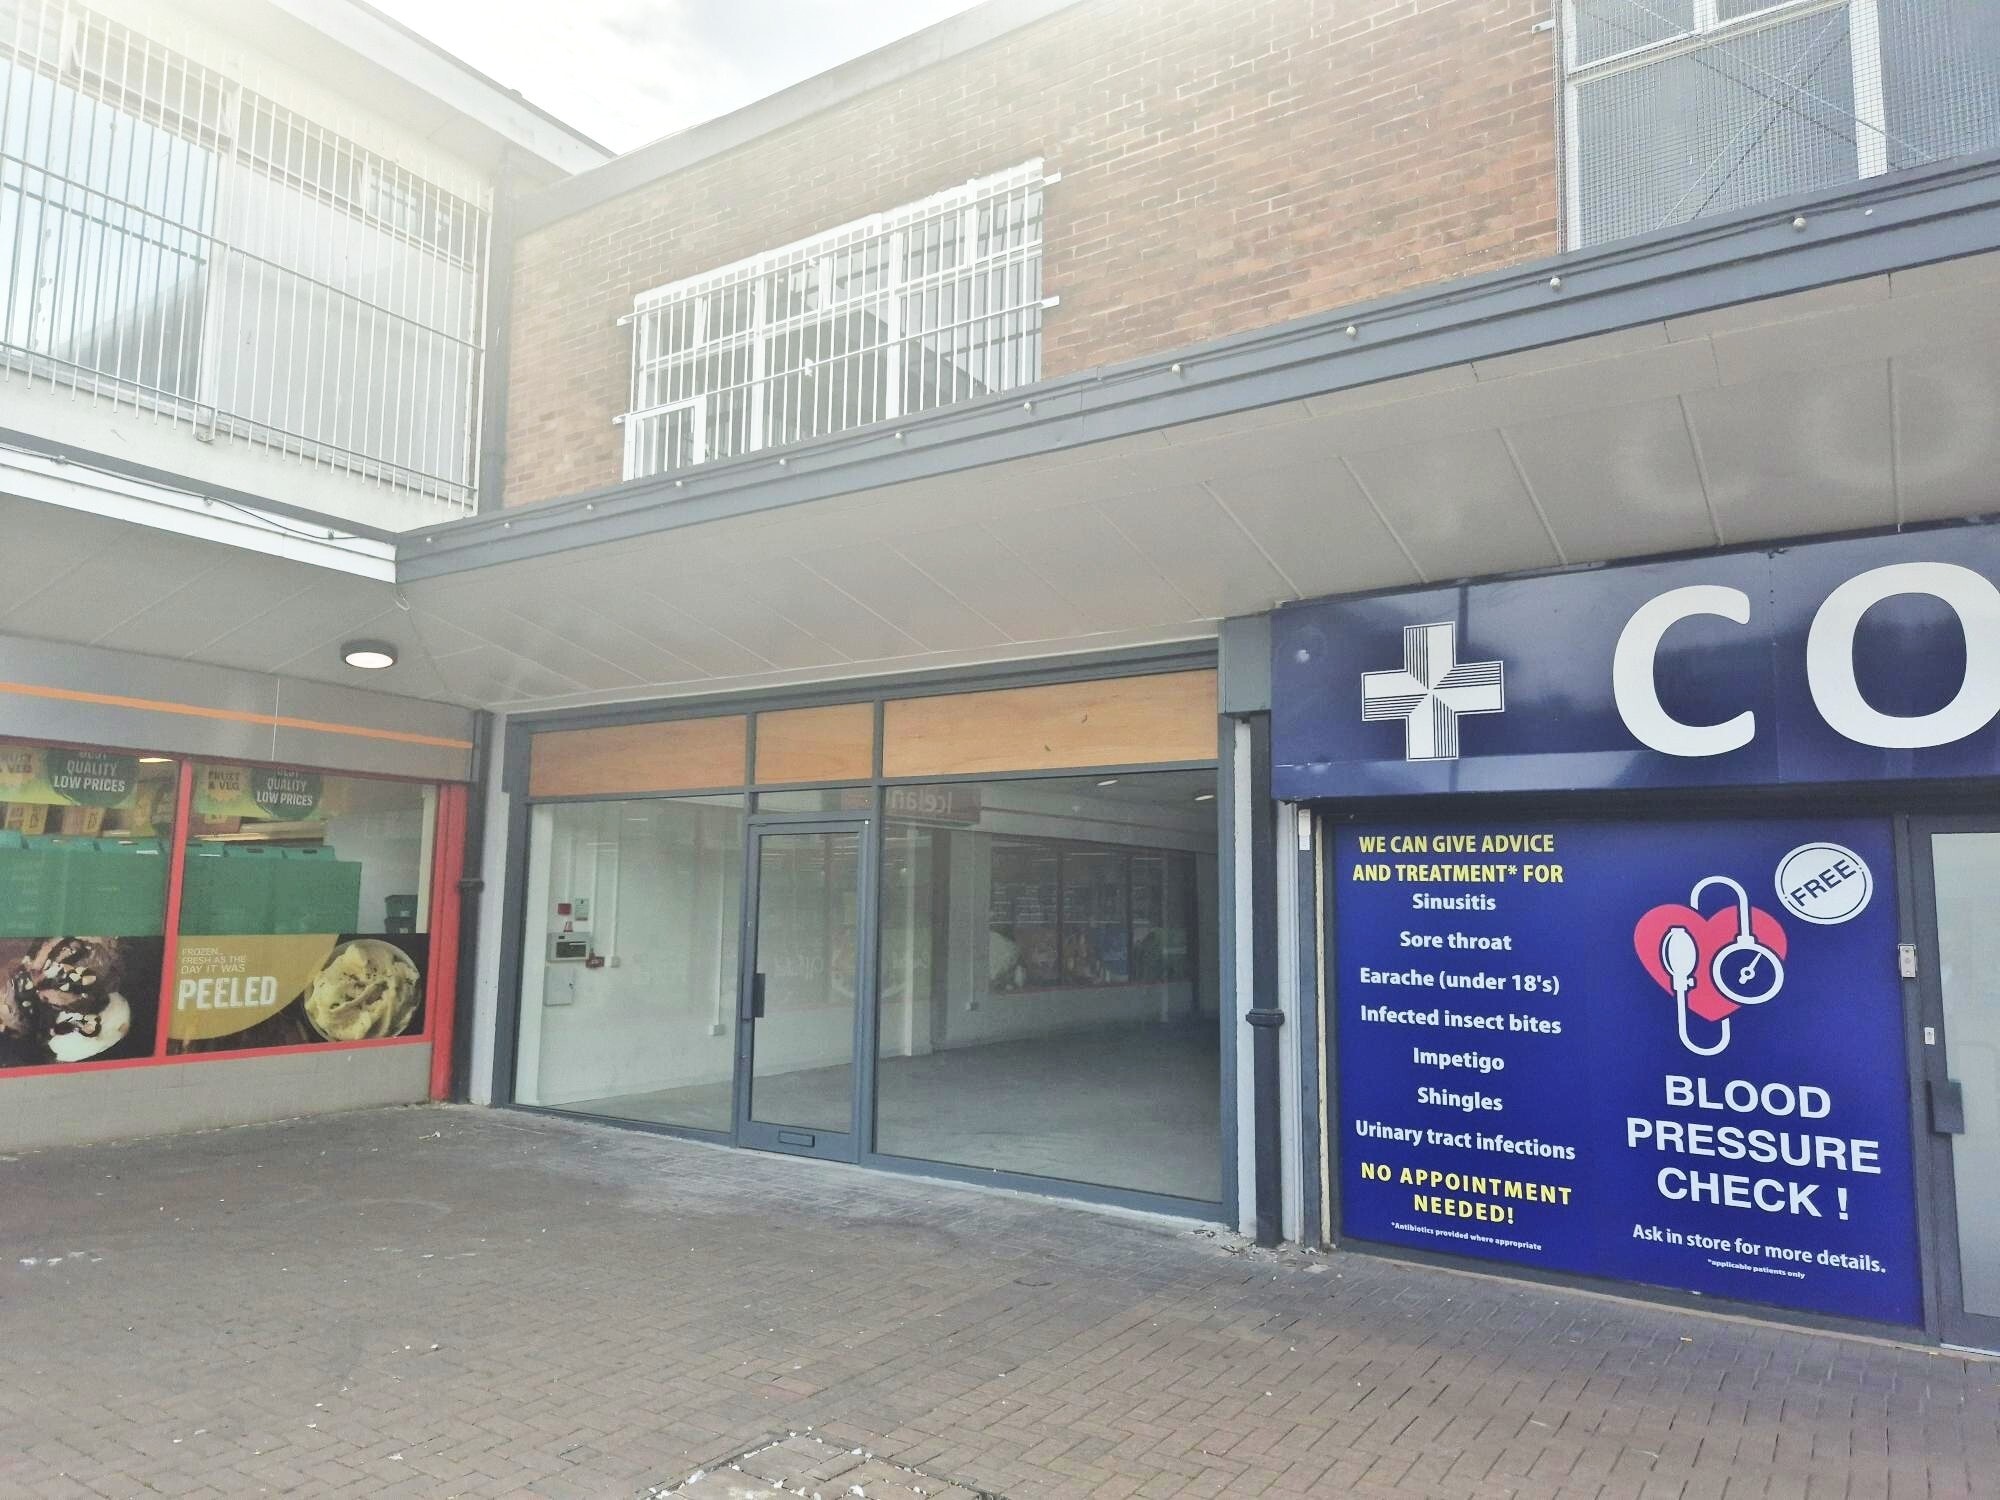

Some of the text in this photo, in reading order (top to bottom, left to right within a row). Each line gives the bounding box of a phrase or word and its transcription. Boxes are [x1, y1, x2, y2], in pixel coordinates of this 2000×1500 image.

[1612, 561, 2000, 758] CO
[66, 760, 118, 776] QUALITY
[54, 775, 125, 792] LOW PRICES
[267, 778, 306, 792] QUALITY
[256, 791, 313, 807] LOW PRICES
[1359, 834, 1555, 853] WE CAN GIVE ADVICE
[1353, 864, 1391, 882] AND
[1523, 865, 1564, 883] FOR
[1789, 858, 1857, 907] FREE
[1412, 893, 1497, 911] Sinusitis
[1400, 931, 1512, 950] Sore throat
[181, 963, 246, 975] DAY IT WAS
[182, 954, 246, 966] FRESH AS THE
[178, 976, 278, 1010] PEELED
[1360, 967, 1560, 995] Earache (under 18's)
[1360, 1005, 1562, 1034] Infected insect bites
[1413, 1047, 1505, 1074] Impetigo
[1417, 1086, 1503, 1112] Shingles
[1665, 1074, 1831, 1119] BLOOD
[1355, 1119, 1576, 1160] Urinary tract infections
[1626, 1117, 1881, 1175] PRESSURE
[1361, 1162, 1572, 1206] NO APPOINTMENT
[1657, 1166, 1849, 1221] CHECK !
[1414, 1194, 1515, 1225] NEEDED!
[1435, 1228, 1469, 1240] provided
[1470, 1234, 1494, 1244] where
[1494, 1238, 1542, 1251] appropriate
[1632, 1223, 1886, 1273] Ask in store for more details.
[1752, 1265, 1787, 1277] patients
[1787, 1270, 1806, 1281] only
